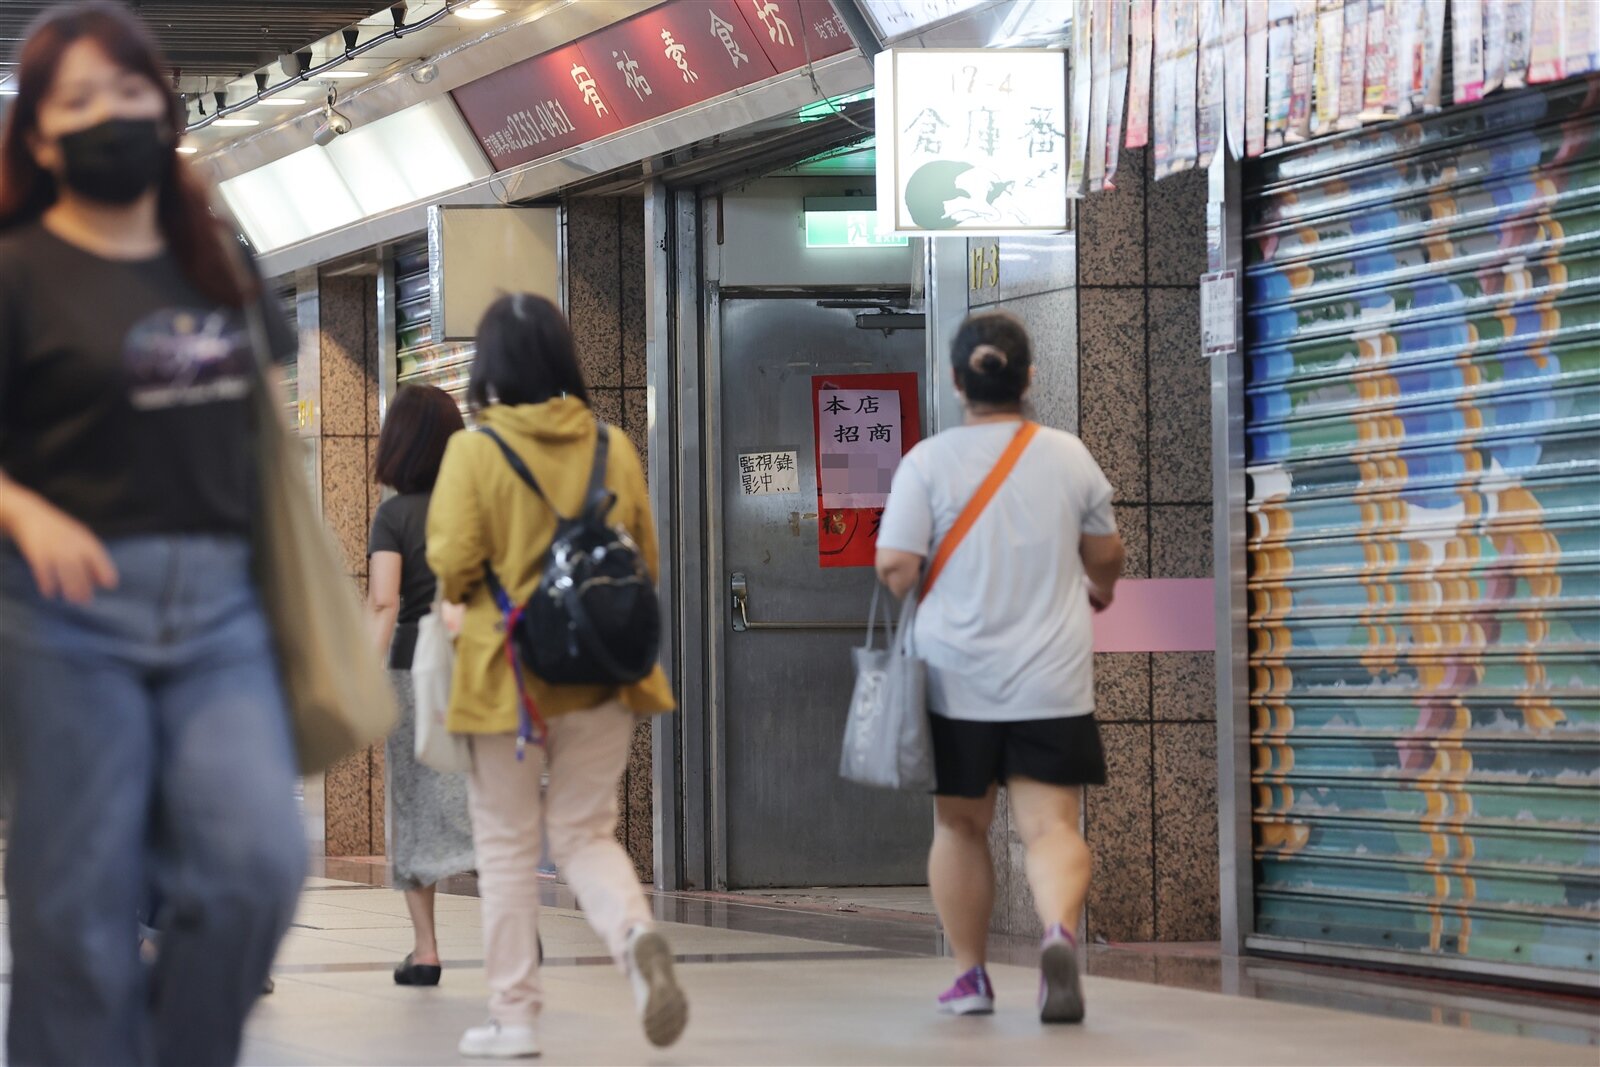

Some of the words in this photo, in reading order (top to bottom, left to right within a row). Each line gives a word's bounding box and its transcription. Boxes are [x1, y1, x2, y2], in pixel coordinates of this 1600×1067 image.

[951, 65, 1013, 97] 17-4
[904, 105, 1066, 159] 倉庫番
[969, 244, 999, 290] 17-3
[823, 395, 880, 415] 本店
[833, 422, 894, 444] 招商
[740, 453, 795, 474] 監視錄
